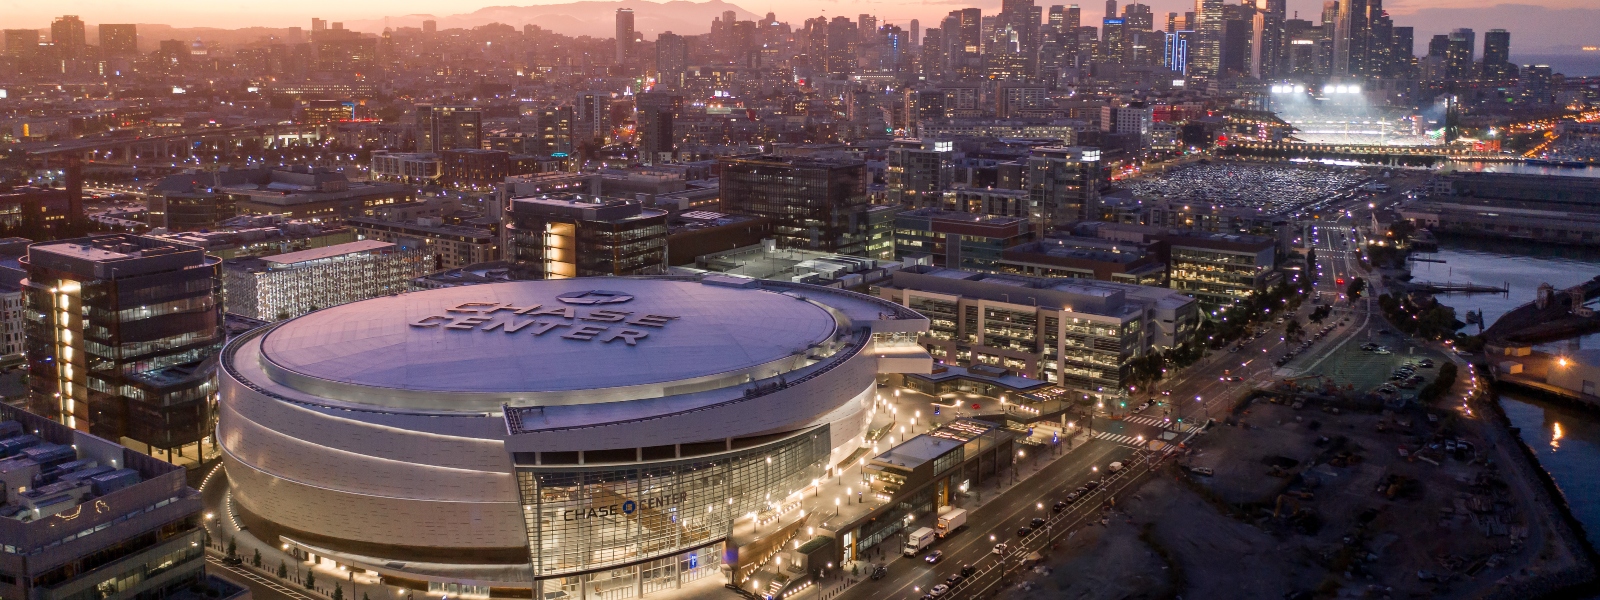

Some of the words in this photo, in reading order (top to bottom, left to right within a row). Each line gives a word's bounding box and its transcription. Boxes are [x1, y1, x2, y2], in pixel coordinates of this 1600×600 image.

[445, 302, 681, 328] CHASE
[409, 315, 650, 346] CENTER
[564, 504, 619, 521] CHASE
[639, 491, 687, 511] CENTER
